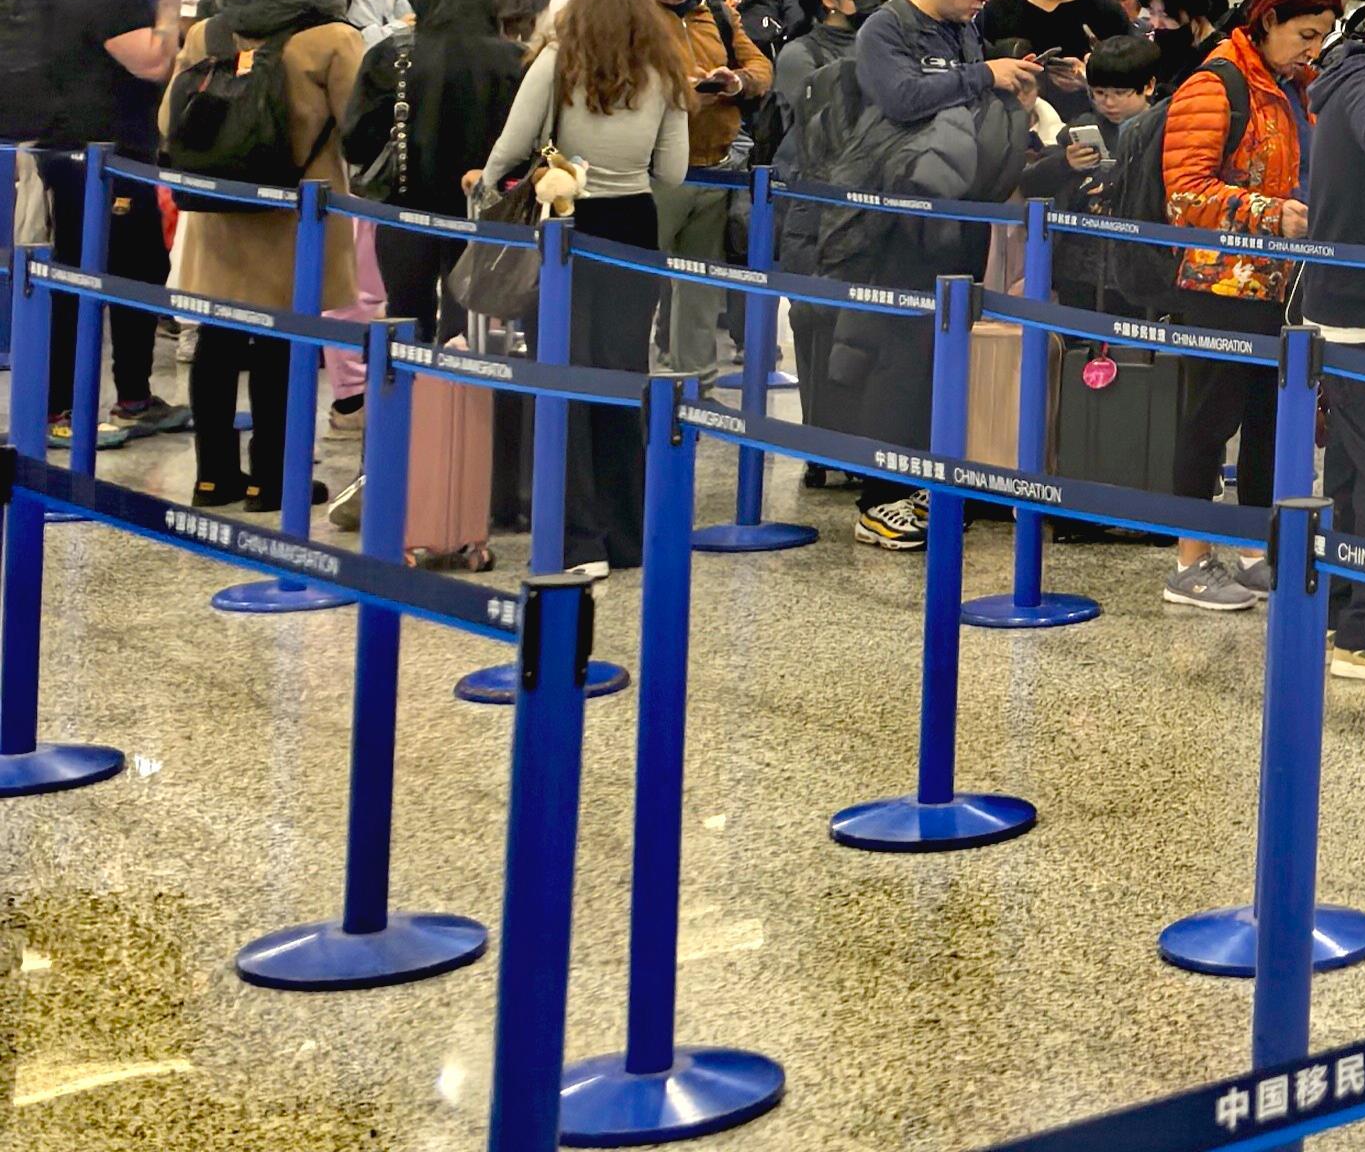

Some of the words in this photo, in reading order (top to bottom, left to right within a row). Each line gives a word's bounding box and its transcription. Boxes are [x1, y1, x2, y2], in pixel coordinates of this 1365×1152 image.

[1267, 240, 1291, 252] CHINA
[1291, 243, 1335, 257] IMMIGRATION
[1113, 321, 1166, 342] 中国移民管理
[1172, 332, 1198, 347] CHINA
[1198, 336, 1253, 354] IMMIGRATION
[874, 450, 946, 482] 中国移民管理
[953, 467, 989, 490] CHINA
[989, 472, 1063, 504] IMMIGRATION
